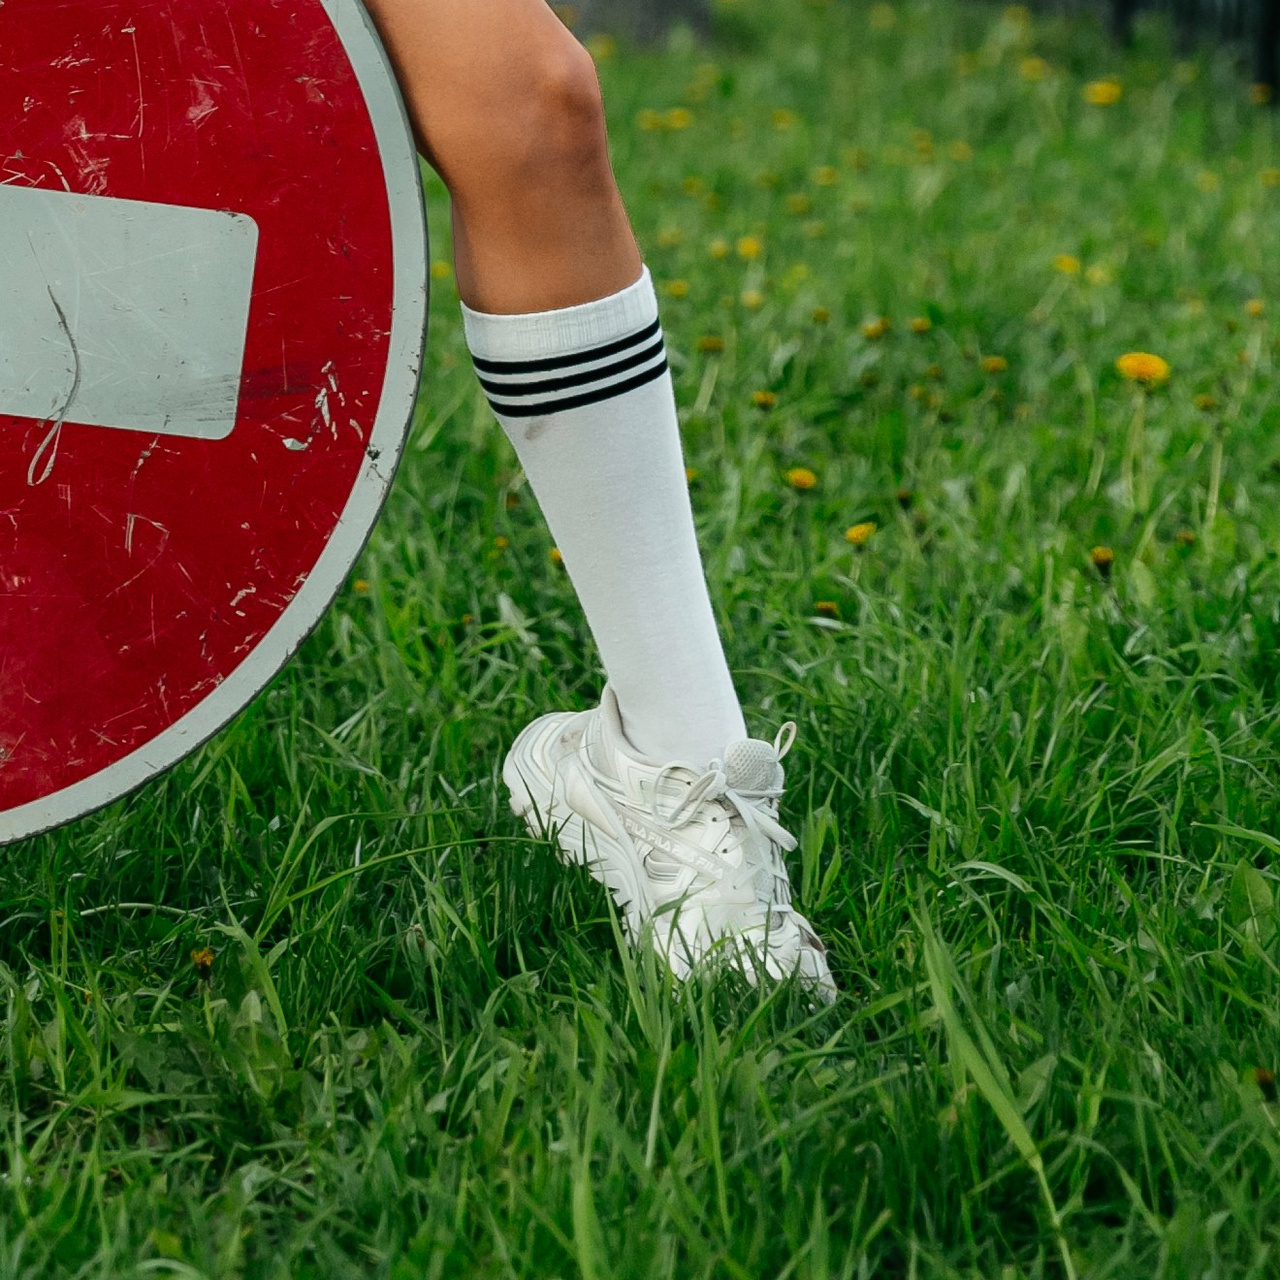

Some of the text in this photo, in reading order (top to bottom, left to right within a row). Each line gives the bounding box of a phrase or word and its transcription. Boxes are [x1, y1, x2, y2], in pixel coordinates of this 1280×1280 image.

[625, 818, 647, 839] FILA
[648, 831, 671, 852] FILA
[695, 856, 723, 880] FILA
